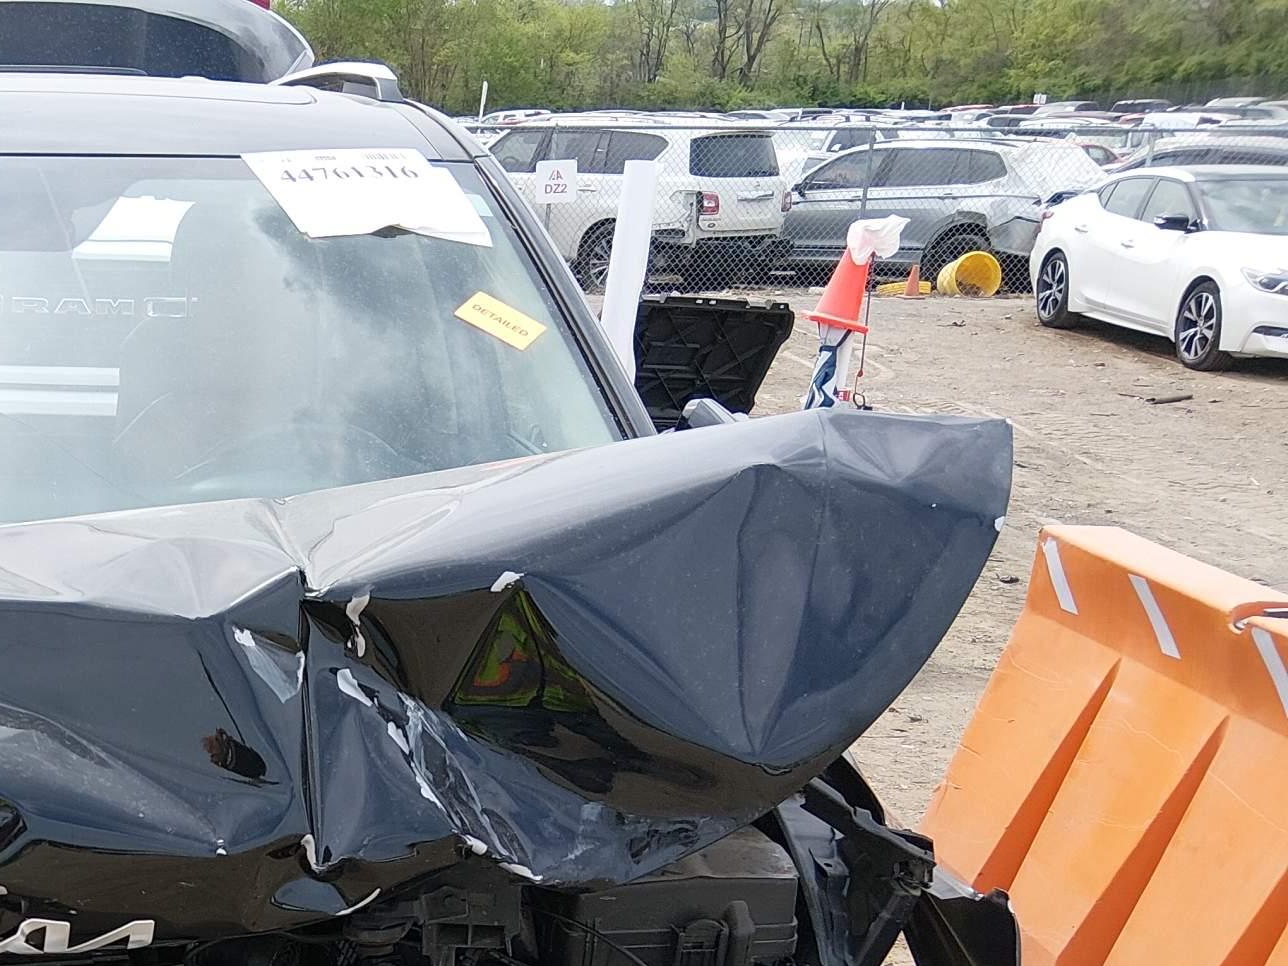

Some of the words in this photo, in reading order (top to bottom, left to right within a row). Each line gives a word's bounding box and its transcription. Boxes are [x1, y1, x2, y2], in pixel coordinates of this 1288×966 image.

[280, 165, 419, 183] 44761316
[544, 183, 569, 195] DZ2
[471, 304, 530, 337] DETAILED
